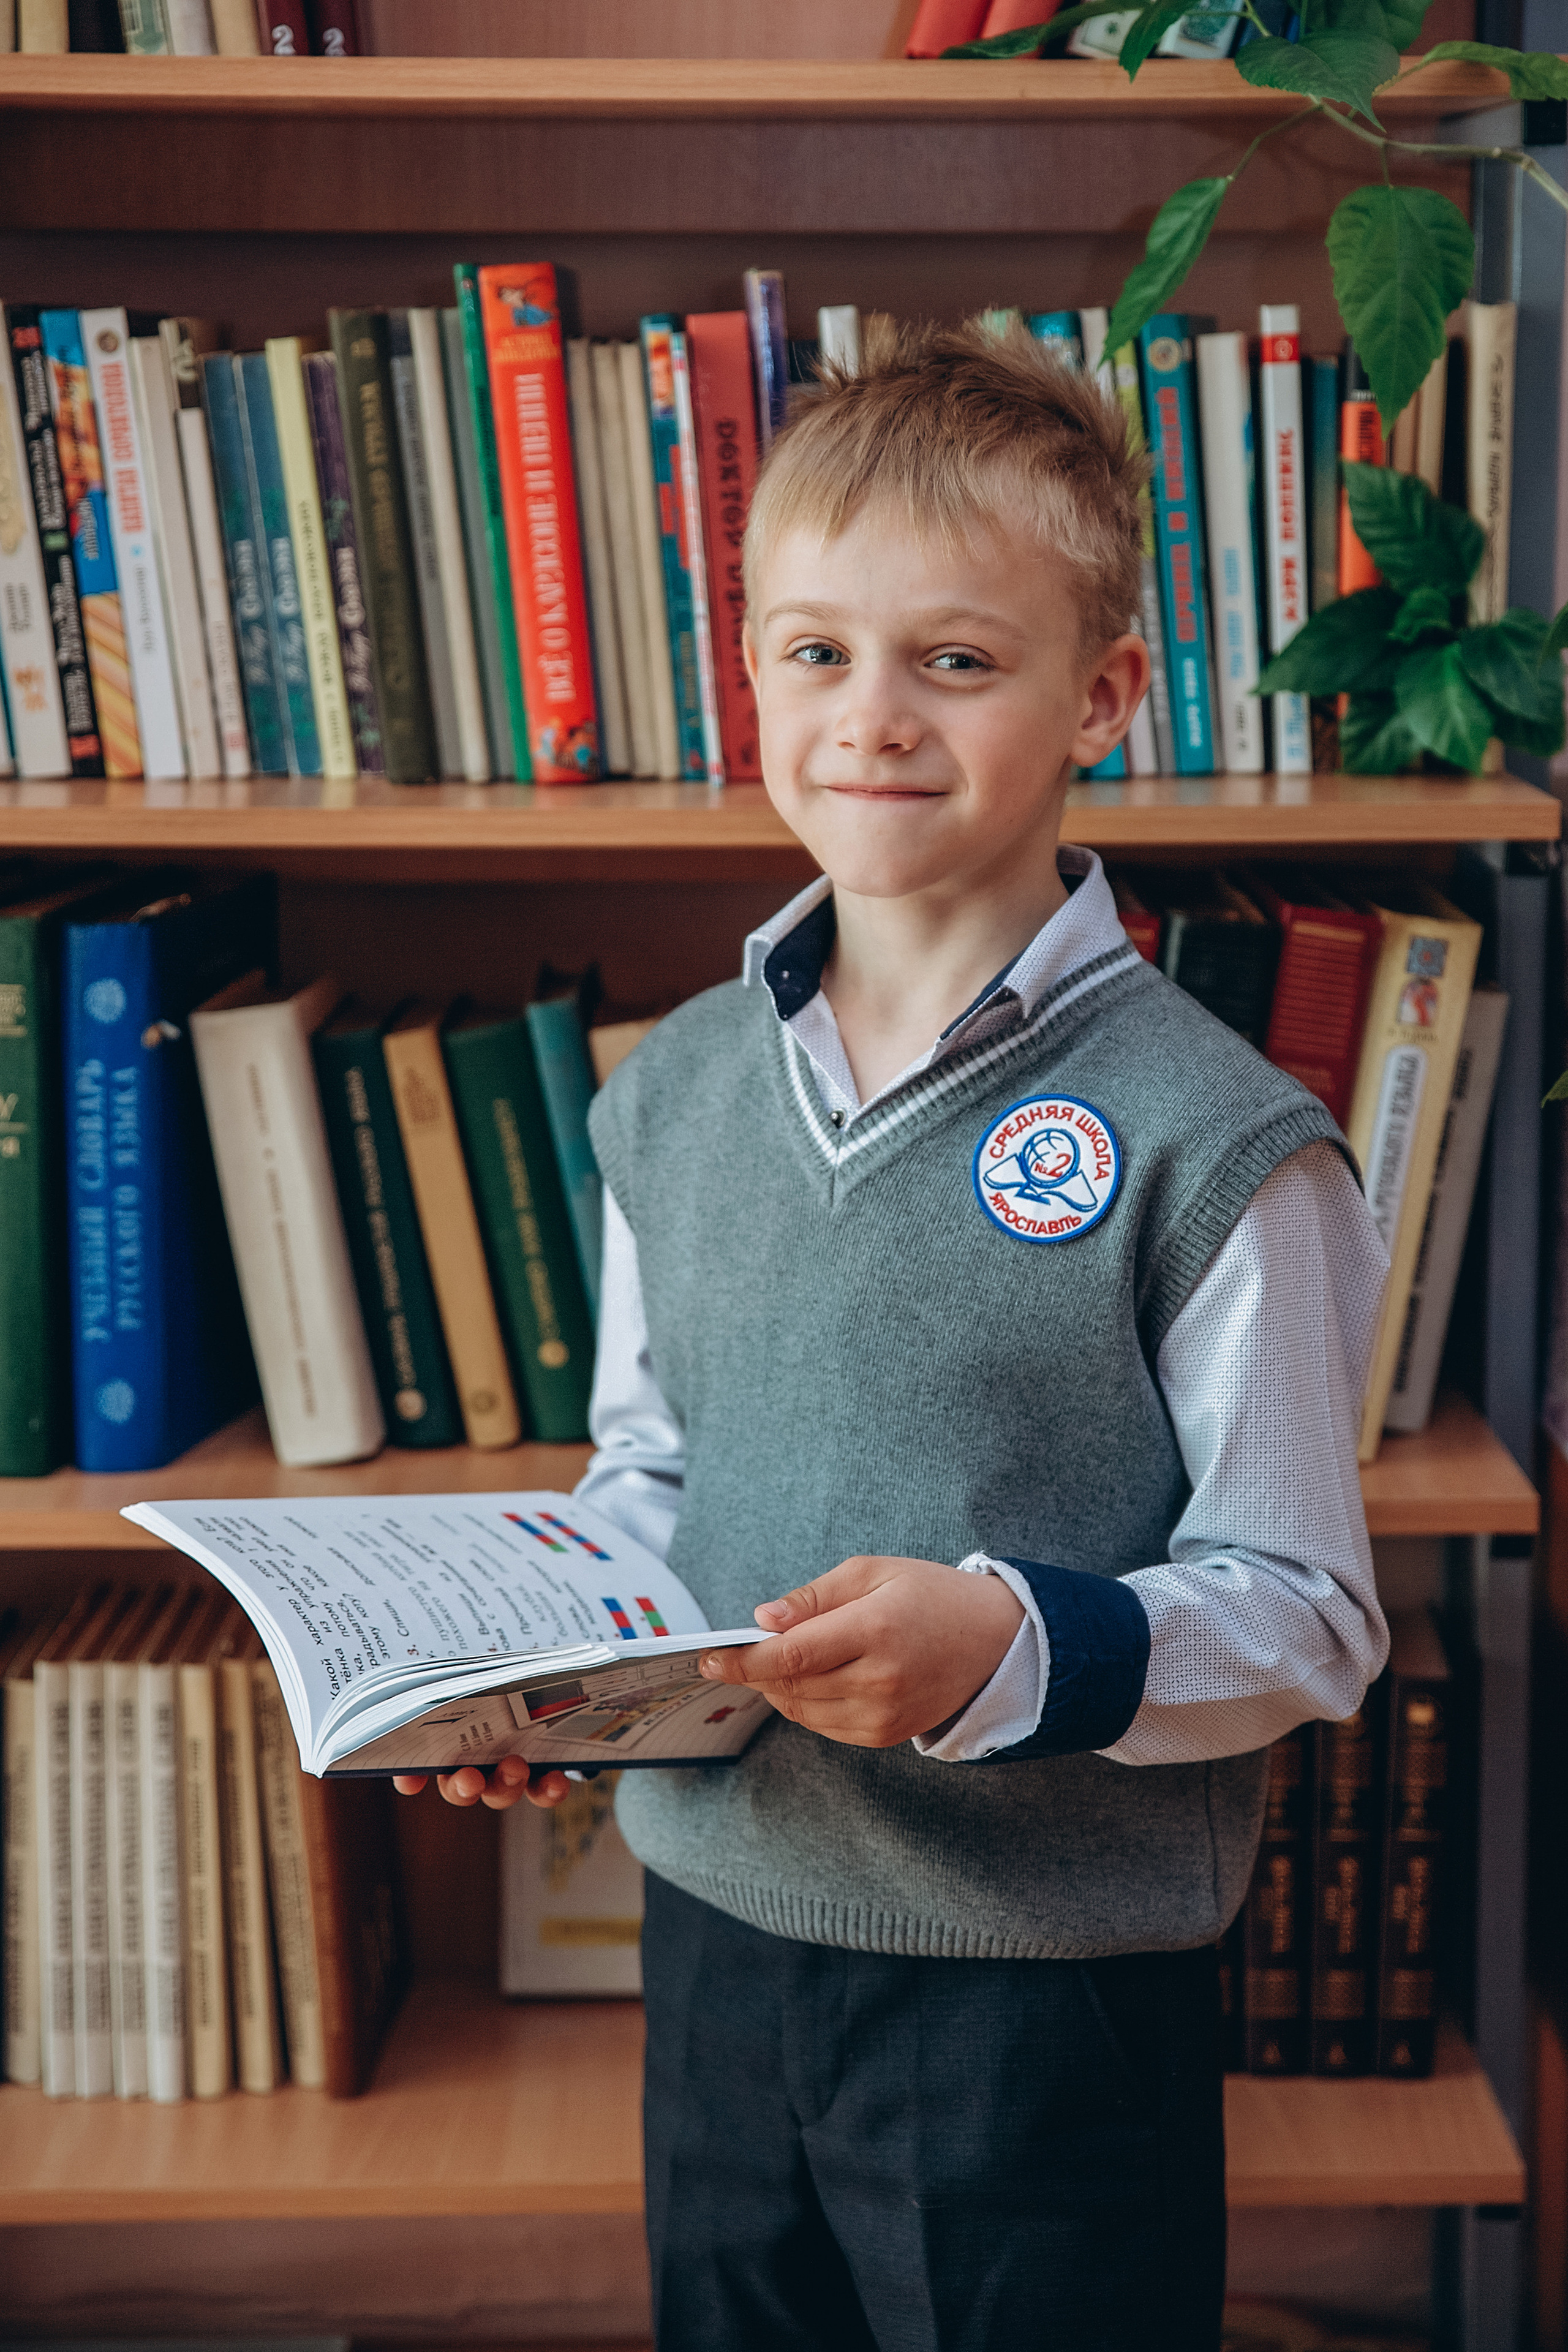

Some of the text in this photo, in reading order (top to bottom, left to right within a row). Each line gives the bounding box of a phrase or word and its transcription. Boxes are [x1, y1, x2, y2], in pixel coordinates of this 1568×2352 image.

[271, 23, 297, 56] 2
[523, 467, 556, 491] И
[526, 494, 570, 625] КАРЛСОНЕ
[539, 627, 571, 650] О
[537, 649, 577, 703] ВСЁ
[74, 1057, 108, 1191] СЛОВАРЬ
[989, 1105, 1112, 1181] СРЕДНЯЯ ШКОЛА
[110, 1066, 143, 1332] РУССКОГО ЯЗЫКА
[989, 1191, 1082, 1234] ЯРОСЛАВЛЬ
[216, 1536, 246, 1553] кота?
[281, 1559, 295, 1569] он
[249, 1558, 274, 1579] этого
[265, 1559, 319, 1609] упражнения
[300, 1577, 316, 1591] что
[303, 1565, 330, 1588] какое
[326, 1546, 377, 1586] дописывая
[288, 1598, 325, 1646] характер
[319, 1620, 333, 1634] из
[320, 1601, 350, 1638] потому
[342, 1593, 391, 1660] этому коту?
[382, 1598, 410, 1638] Спиши,
[407, 1586, 450, 1642] пушистого
[431, 1596, 468, 1650] похожего
[458, 1593, 490, 1635] Выпиши
[494, 1586, 533, 1635] Прочитай
[337, 1599, 382, 1670] радываться,
[407, 1645, 420, 1656] 3.
[496, 1627, 511, 1651] ова
[320, 1658, 341, 1700] Какой
[334, 1648, 352, 1684] тёнка
[353, 1653, 366, 1676] ка,
